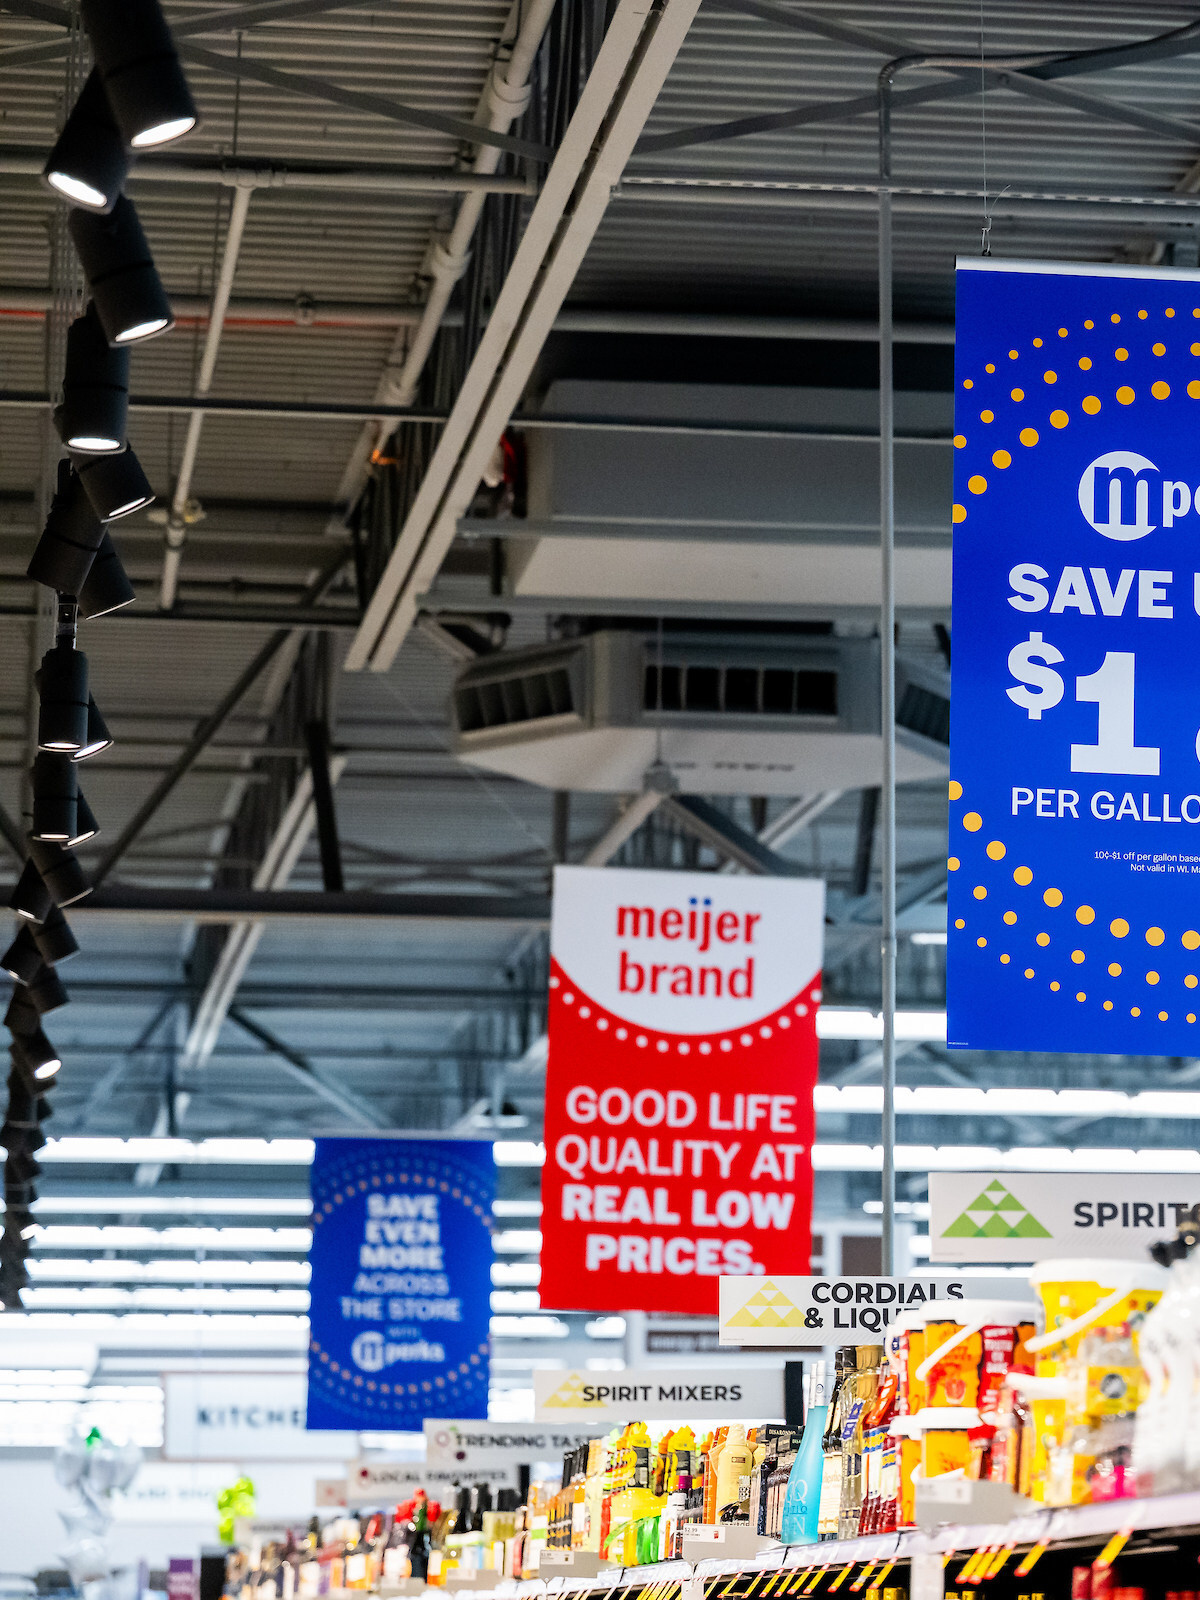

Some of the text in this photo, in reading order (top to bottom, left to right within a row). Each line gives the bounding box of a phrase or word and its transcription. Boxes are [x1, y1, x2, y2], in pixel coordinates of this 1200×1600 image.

[1007, 563, 1173, 619] SAVE
[1005, 632, 1161, 776] $1
[1011, 787, 1080, 819] PER
[1123, 852, 1136, 861] off
[1137, 853, 1151, 862] per
[1153, 853, 1178, 863] gallon
[1130, 863, 1145, 872] Not
[1147, 864, 1165, 873] valid
[1167, 865, 1175, 873] in
[616, 897, 761, 953] meijer
[618, 951, 754, 999] brand
[565, 1086, 797, 1133] GOOD LIFE
[555, 1134, 805, 1181] QUALITY AT
[367, 1194, 438, 1219] SAVE
[561, 1184, 796, 1231] REAL LOW
[1074, 1202, 1192, 1228] SPIRIT
[365, 1220, 440, 1244] EVEN
[360, 1245, 443, 1270] MORE
[585, 1234, 768, 1277] PRICES.
[353, 1272, 450, 1296] ACROSS
[811, 1282, 964, 1304] CORDIALS
[341, 1296, 462, 1322] THE STORE
[804, 1307, 915, 1334] & LIQU
[583, 1385, 742, 1402] SPIRIT MIXERS
[197, 1406, 307, 1426] KITCHE
[455, 1434, 546, 1448] TRENDING
